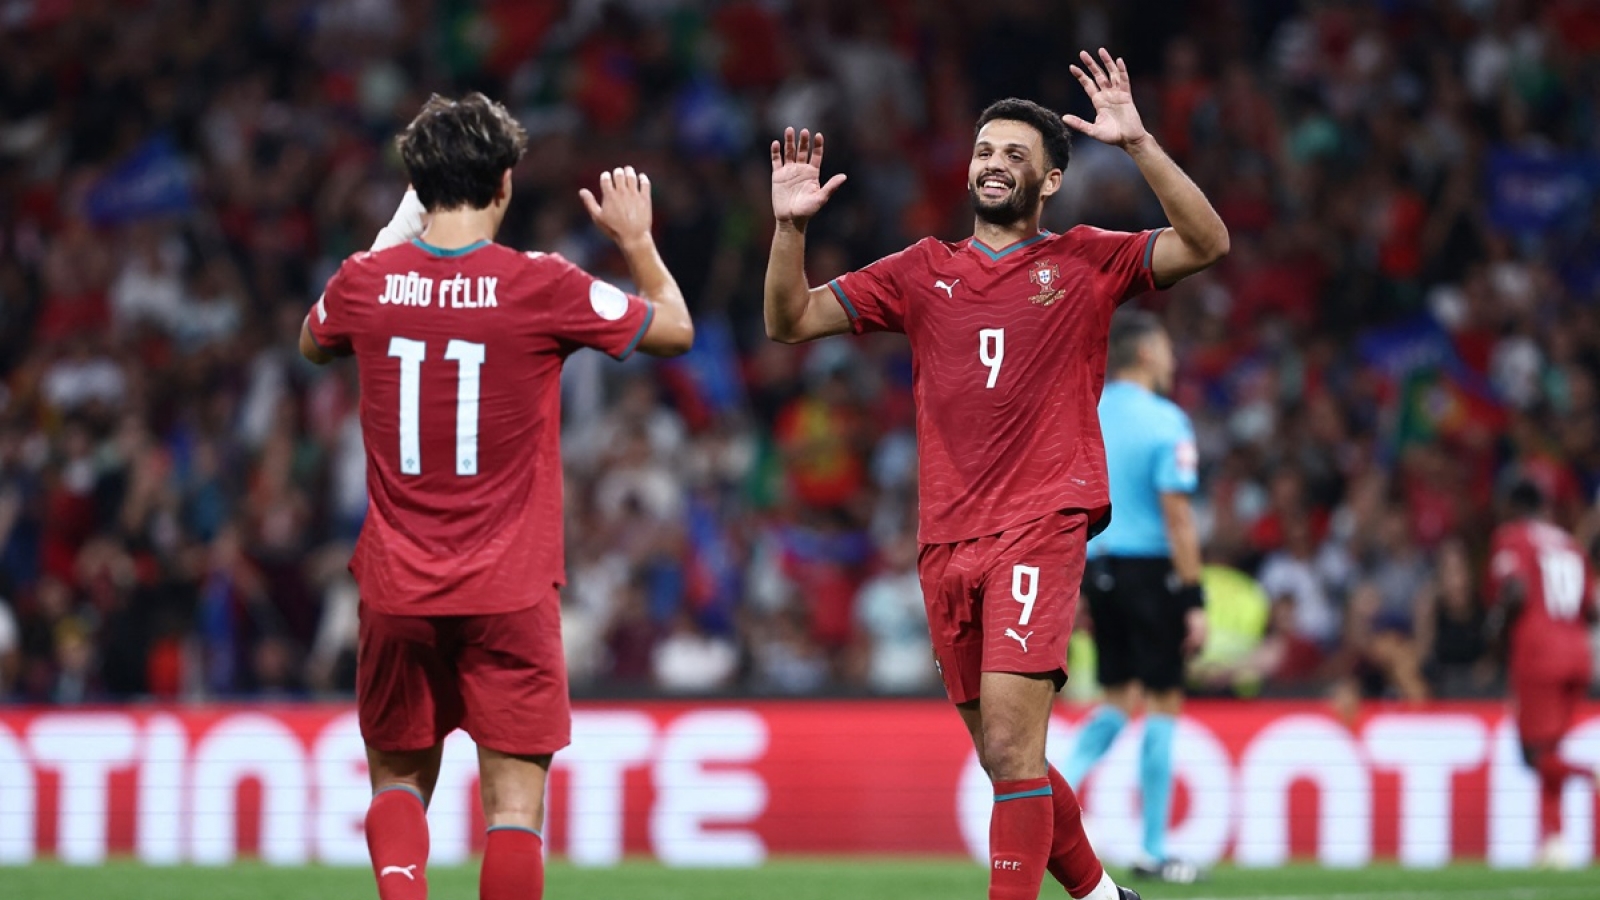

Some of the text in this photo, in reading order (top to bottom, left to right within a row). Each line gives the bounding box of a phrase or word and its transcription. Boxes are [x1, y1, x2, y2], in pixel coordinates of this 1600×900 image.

[378, 271, 498, 308] JOÃO FÉLIX
[979, 328, 1005, 389] 9
[388, 337, 486, 476] 11
[1011, 564, 1040, 626] 9
